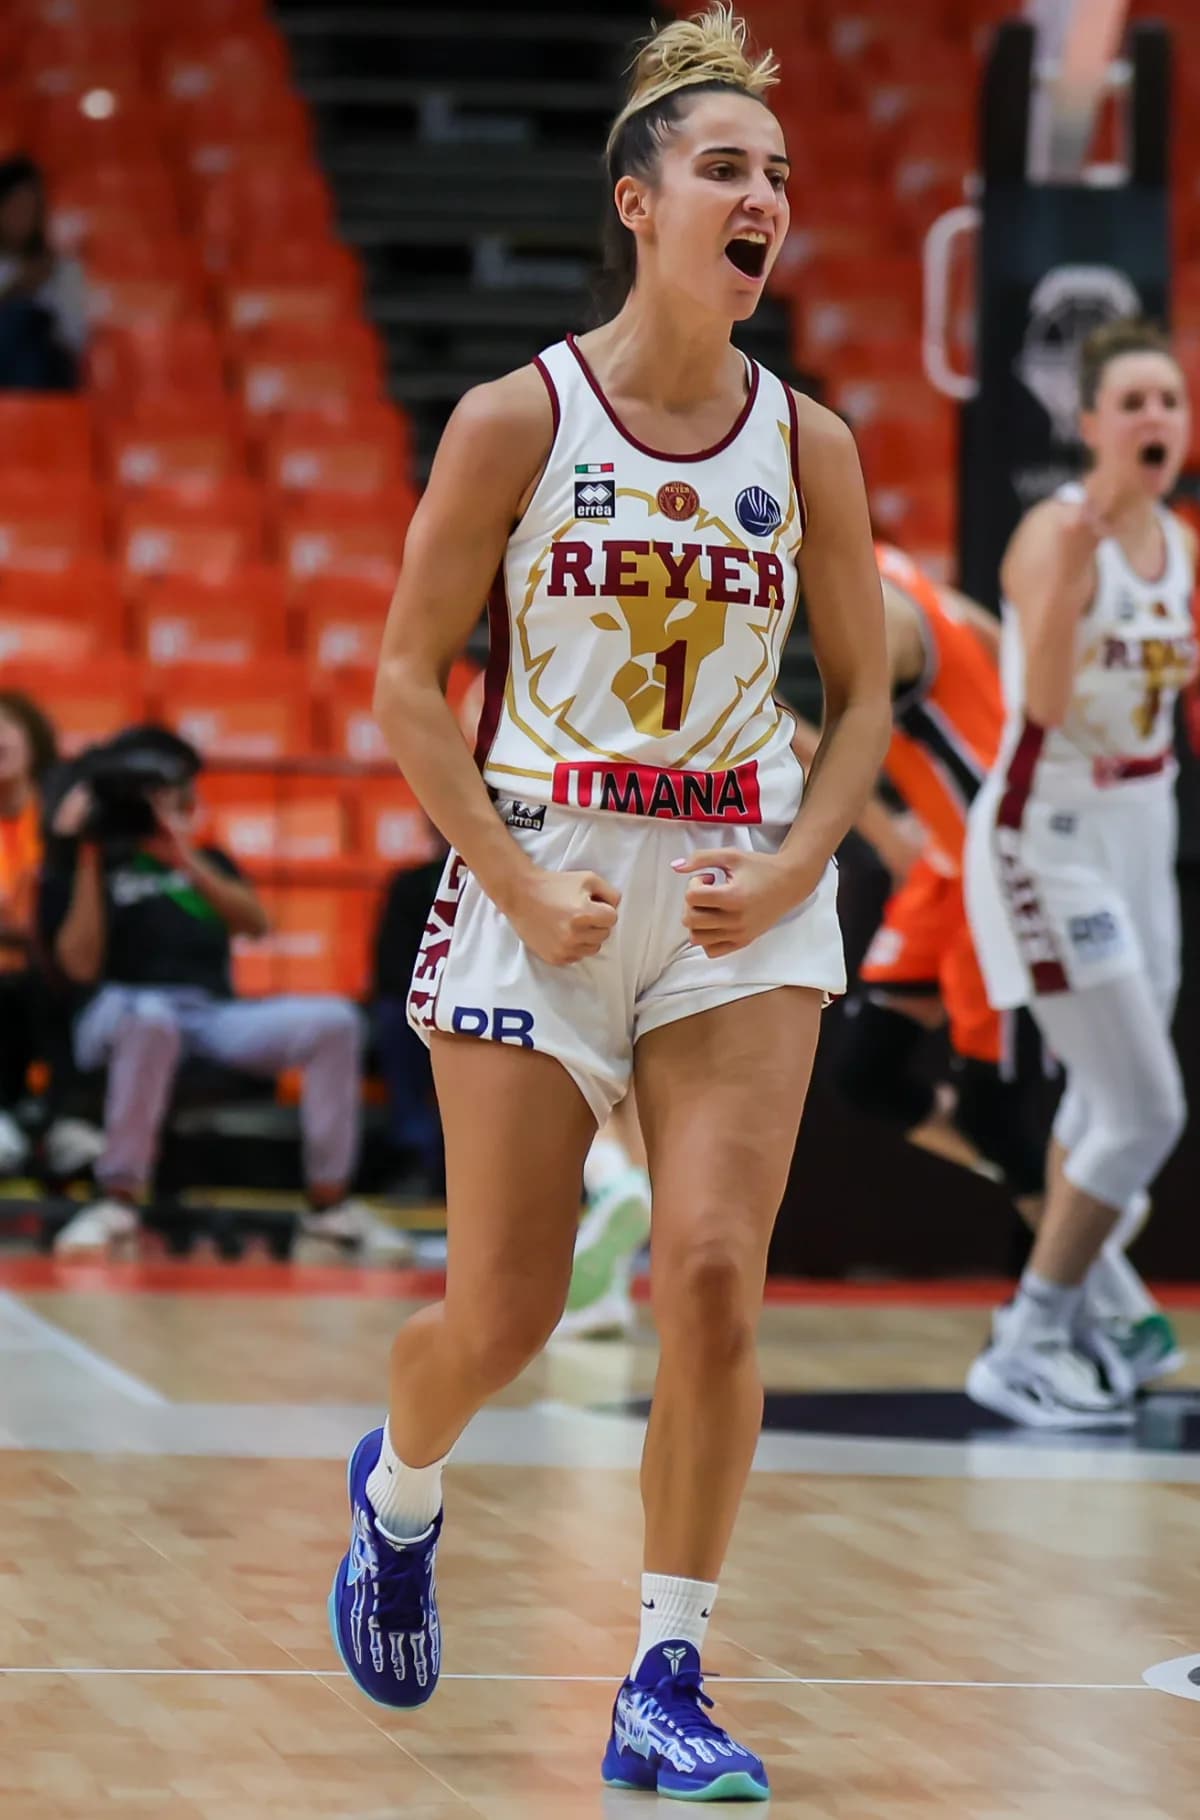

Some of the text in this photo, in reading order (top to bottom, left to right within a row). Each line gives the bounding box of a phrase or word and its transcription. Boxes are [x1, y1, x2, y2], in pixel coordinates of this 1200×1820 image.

[577, 505, 612, 517] errea
[547, 541, 785, 611] REYER
[655, 640, 687, 732] 1
[566, 769, 748, 817] UMANA
